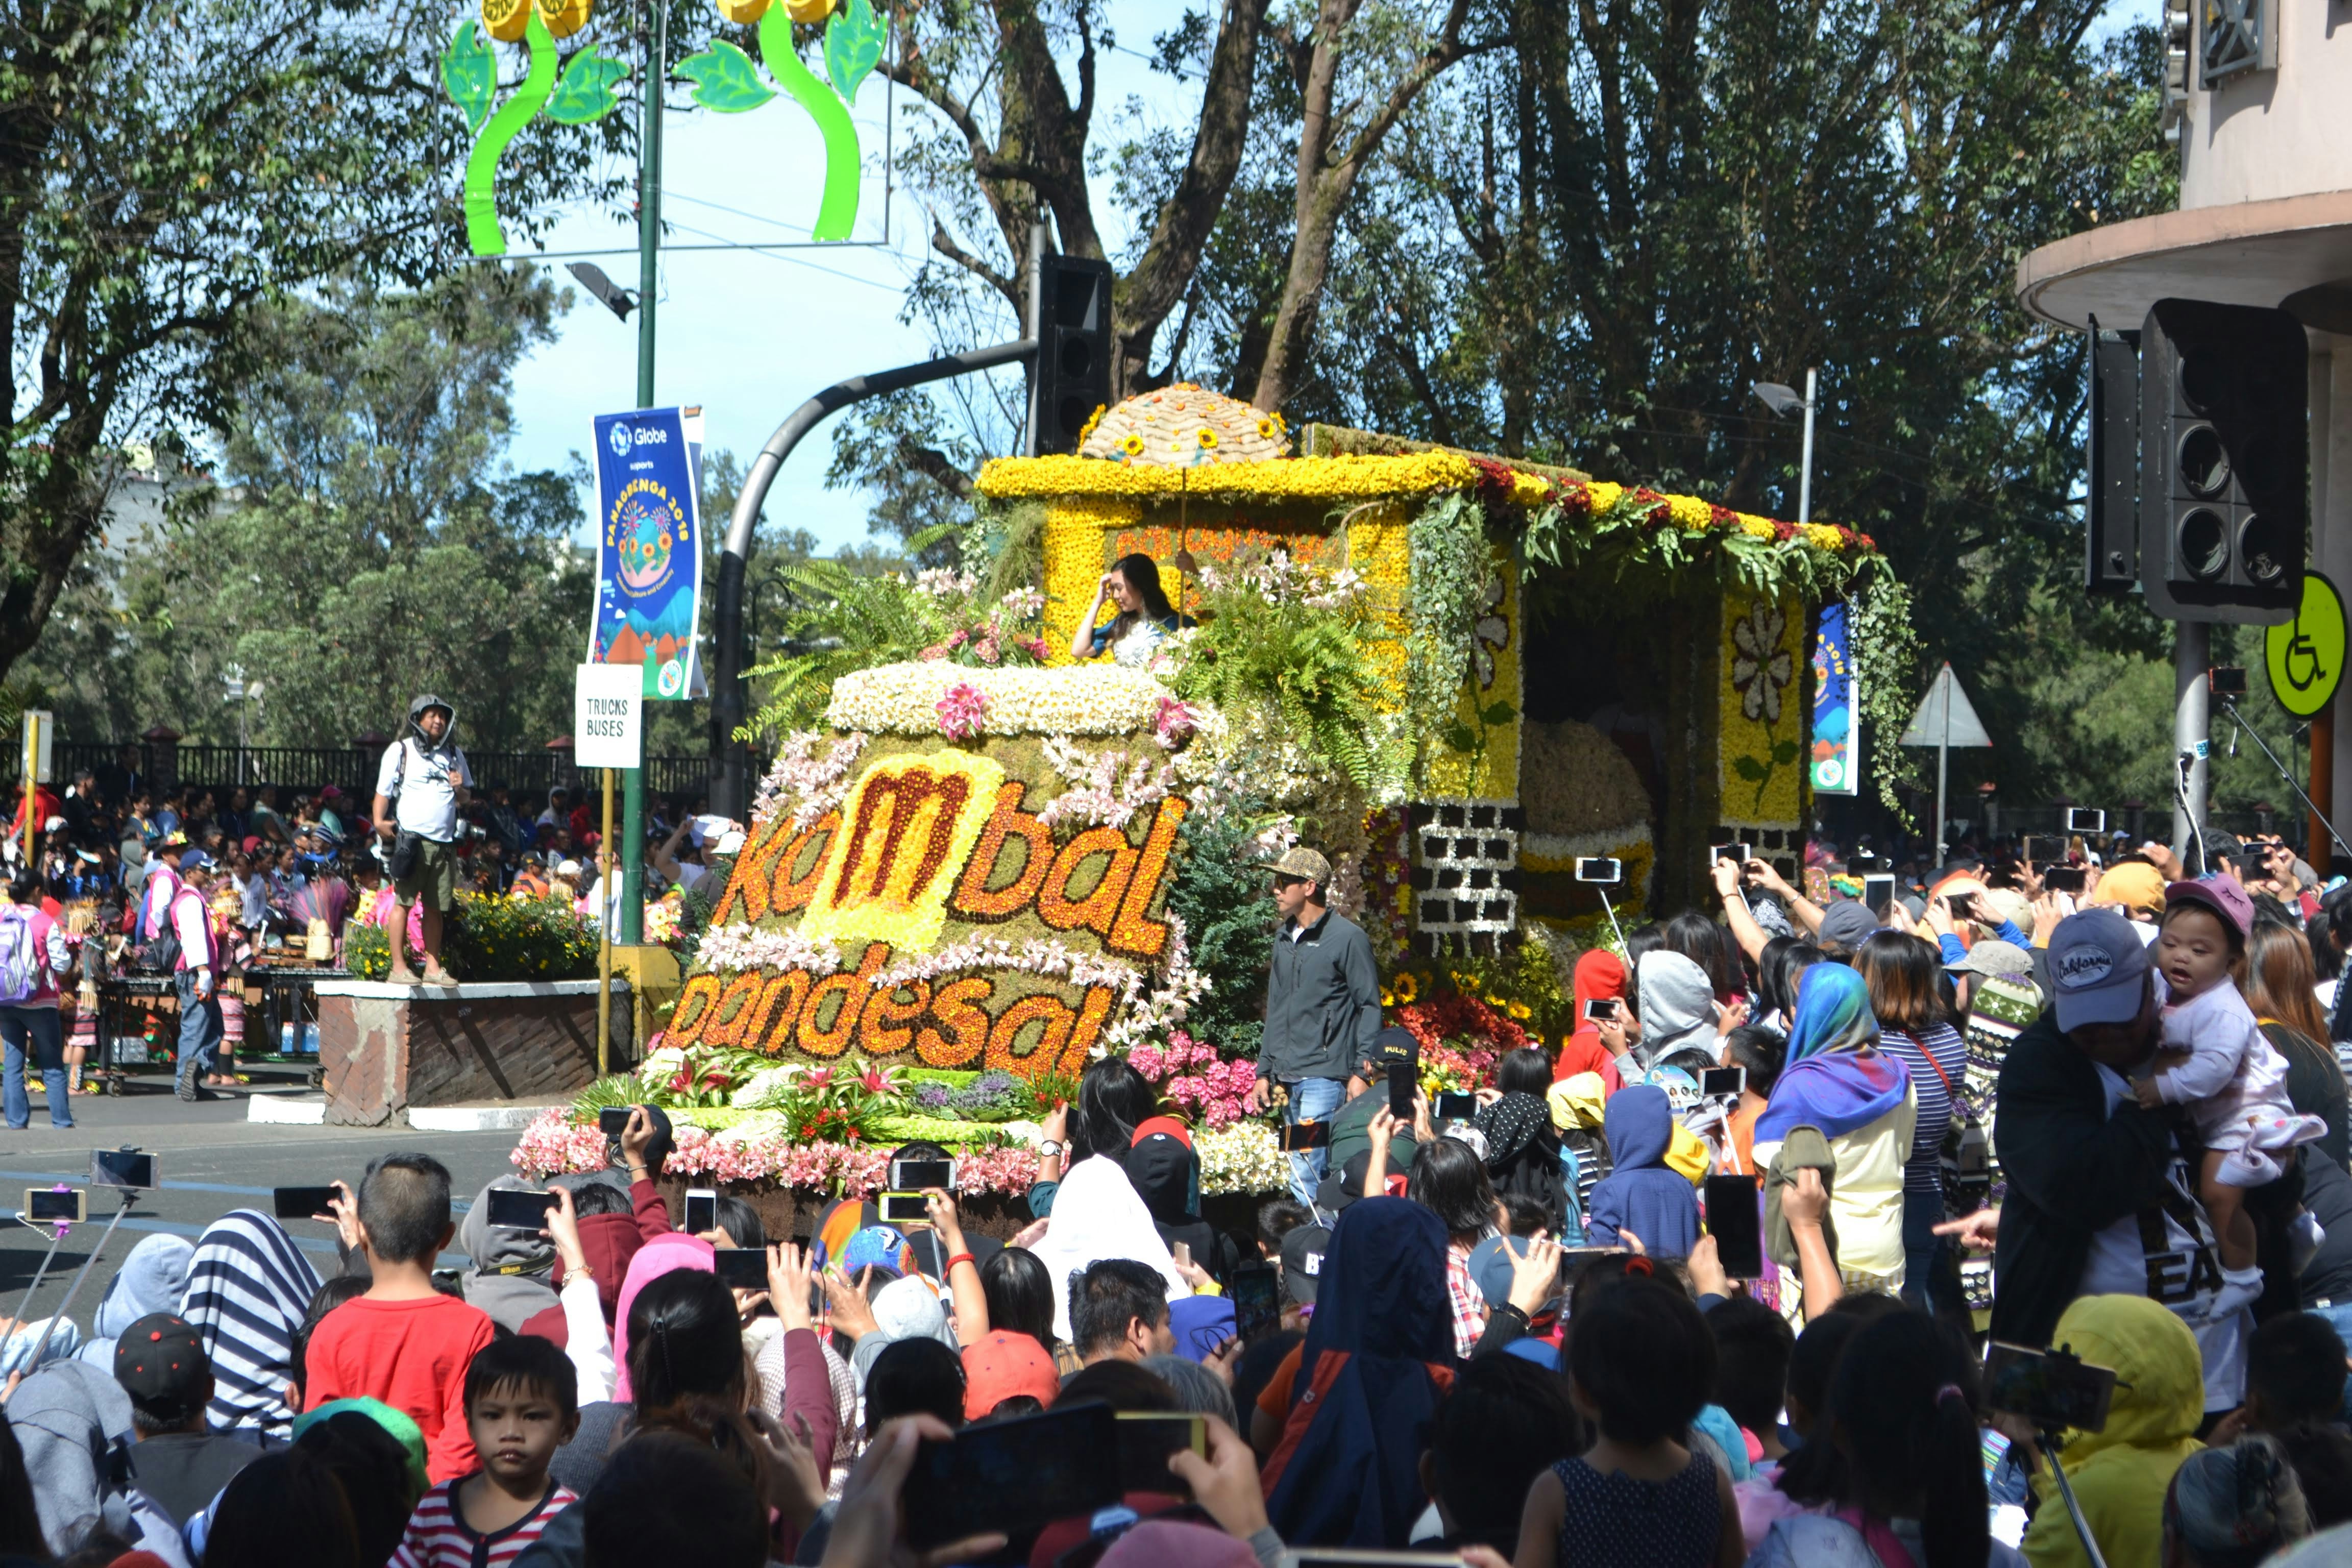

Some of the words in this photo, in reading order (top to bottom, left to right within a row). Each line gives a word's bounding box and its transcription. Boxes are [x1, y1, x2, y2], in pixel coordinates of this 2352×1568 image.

[635, 427, 667, 445] Globe
[668, 496, 689, 541] 2018
[587, 699, 628, 716] TRUCKS
[587, 720, 624, 737] BUSES
[2057, 955, 2112, 979] California
[1384, 1045, 1408, 1057] PULIS
[500, 1265, 521, 1275] Nikon
